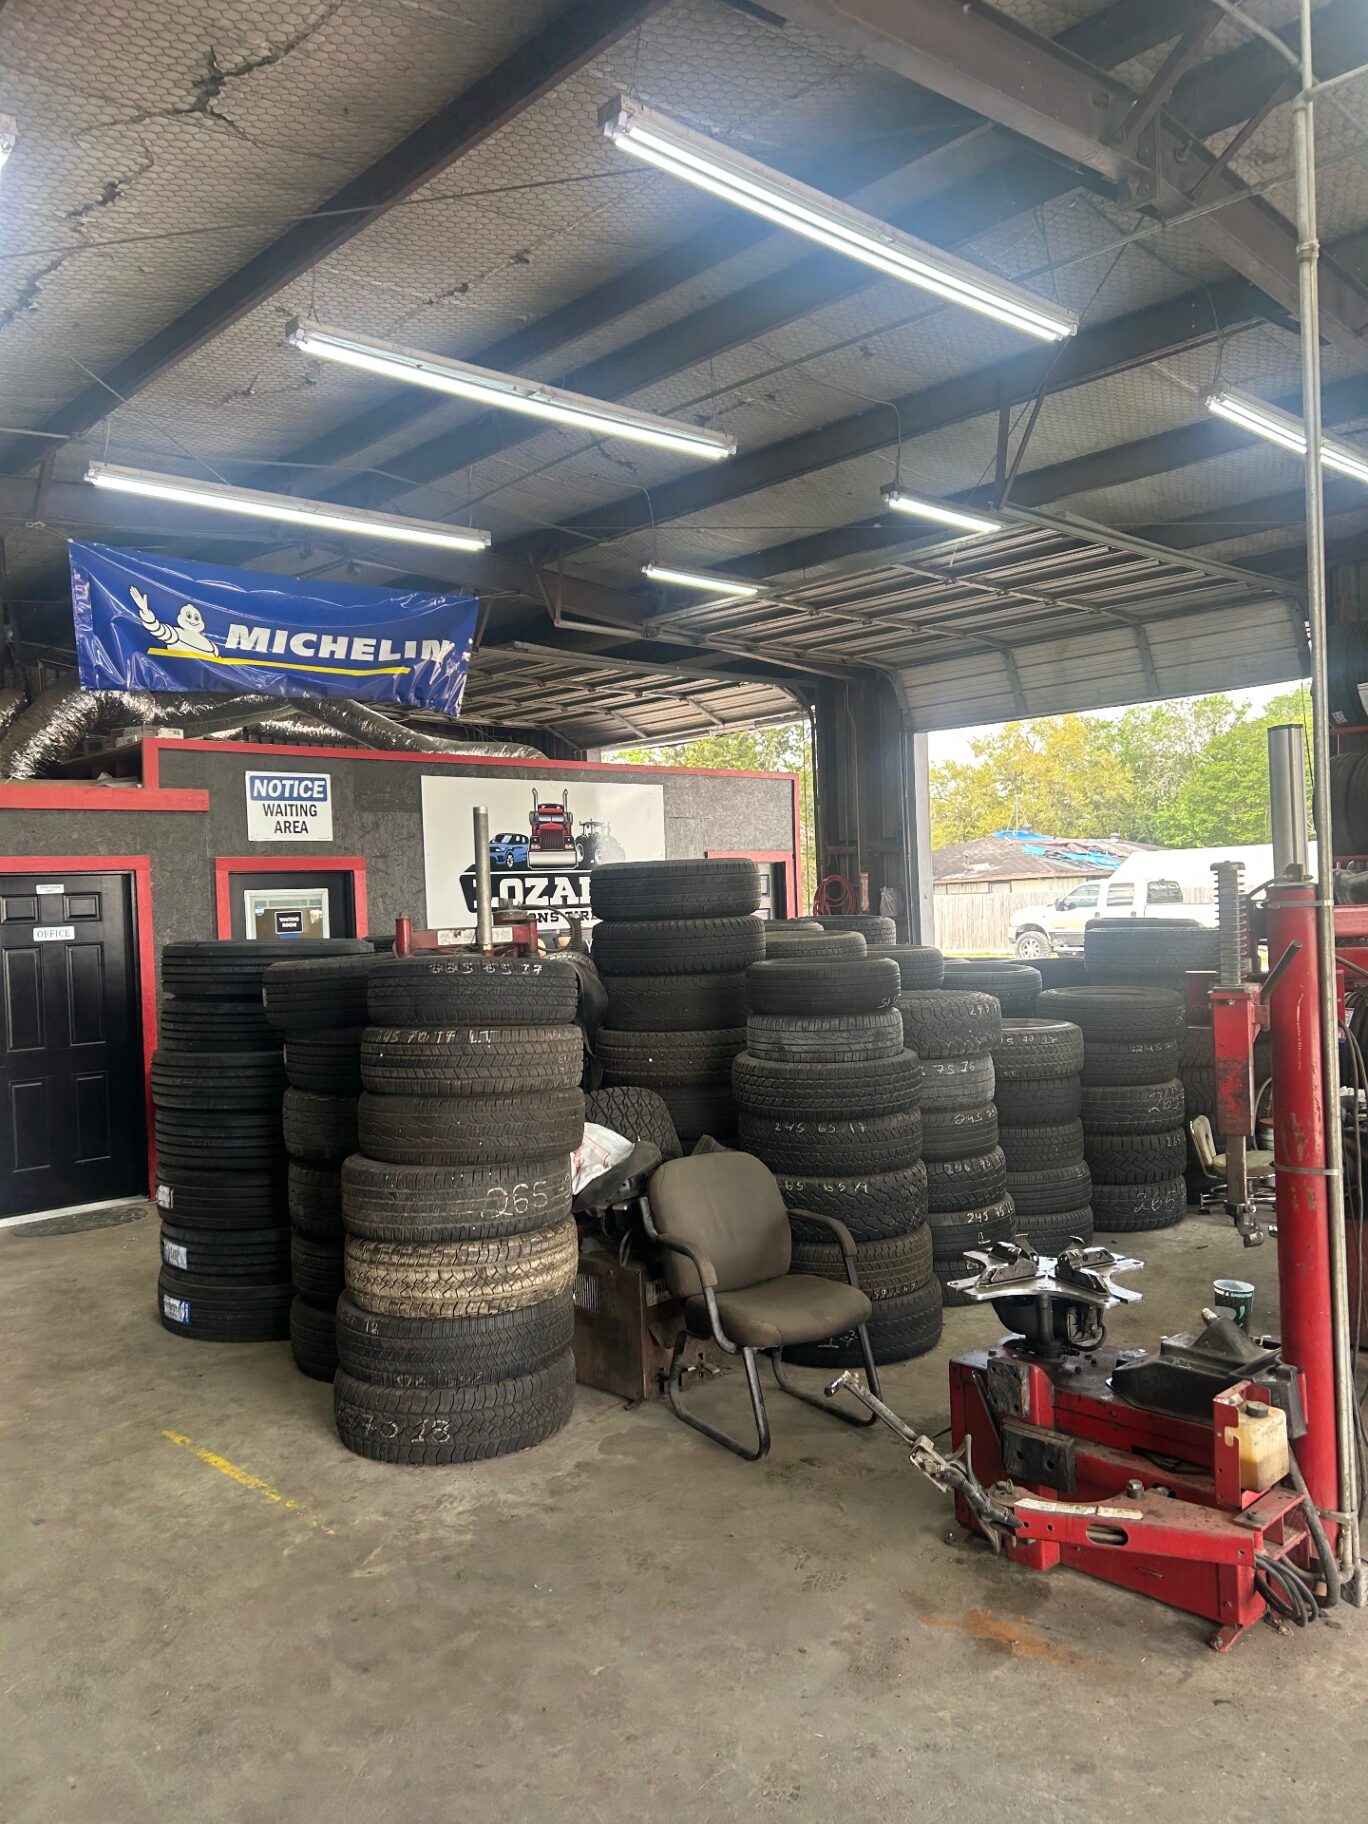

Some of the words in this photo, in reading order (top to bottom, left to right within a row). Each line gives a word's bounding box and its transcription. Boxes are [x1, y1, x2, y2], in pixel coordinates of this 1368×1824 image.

[225, 623, 455, 661] MICHELIN
[253, 779, 326, 798] NOTICE
[262, 803, 318, 817] WAITING
[274, 820, 309, 834] AREA
[36, 928, 71, 939] OFFICE
[775, 1122, 805, 1133] 245
[818, 1123, 836, 1134] 65
[779, 1181, 804, 1191] 65
[481, 1182, 548, 1219] 265
[966, 1210, 989, 1223] 245
